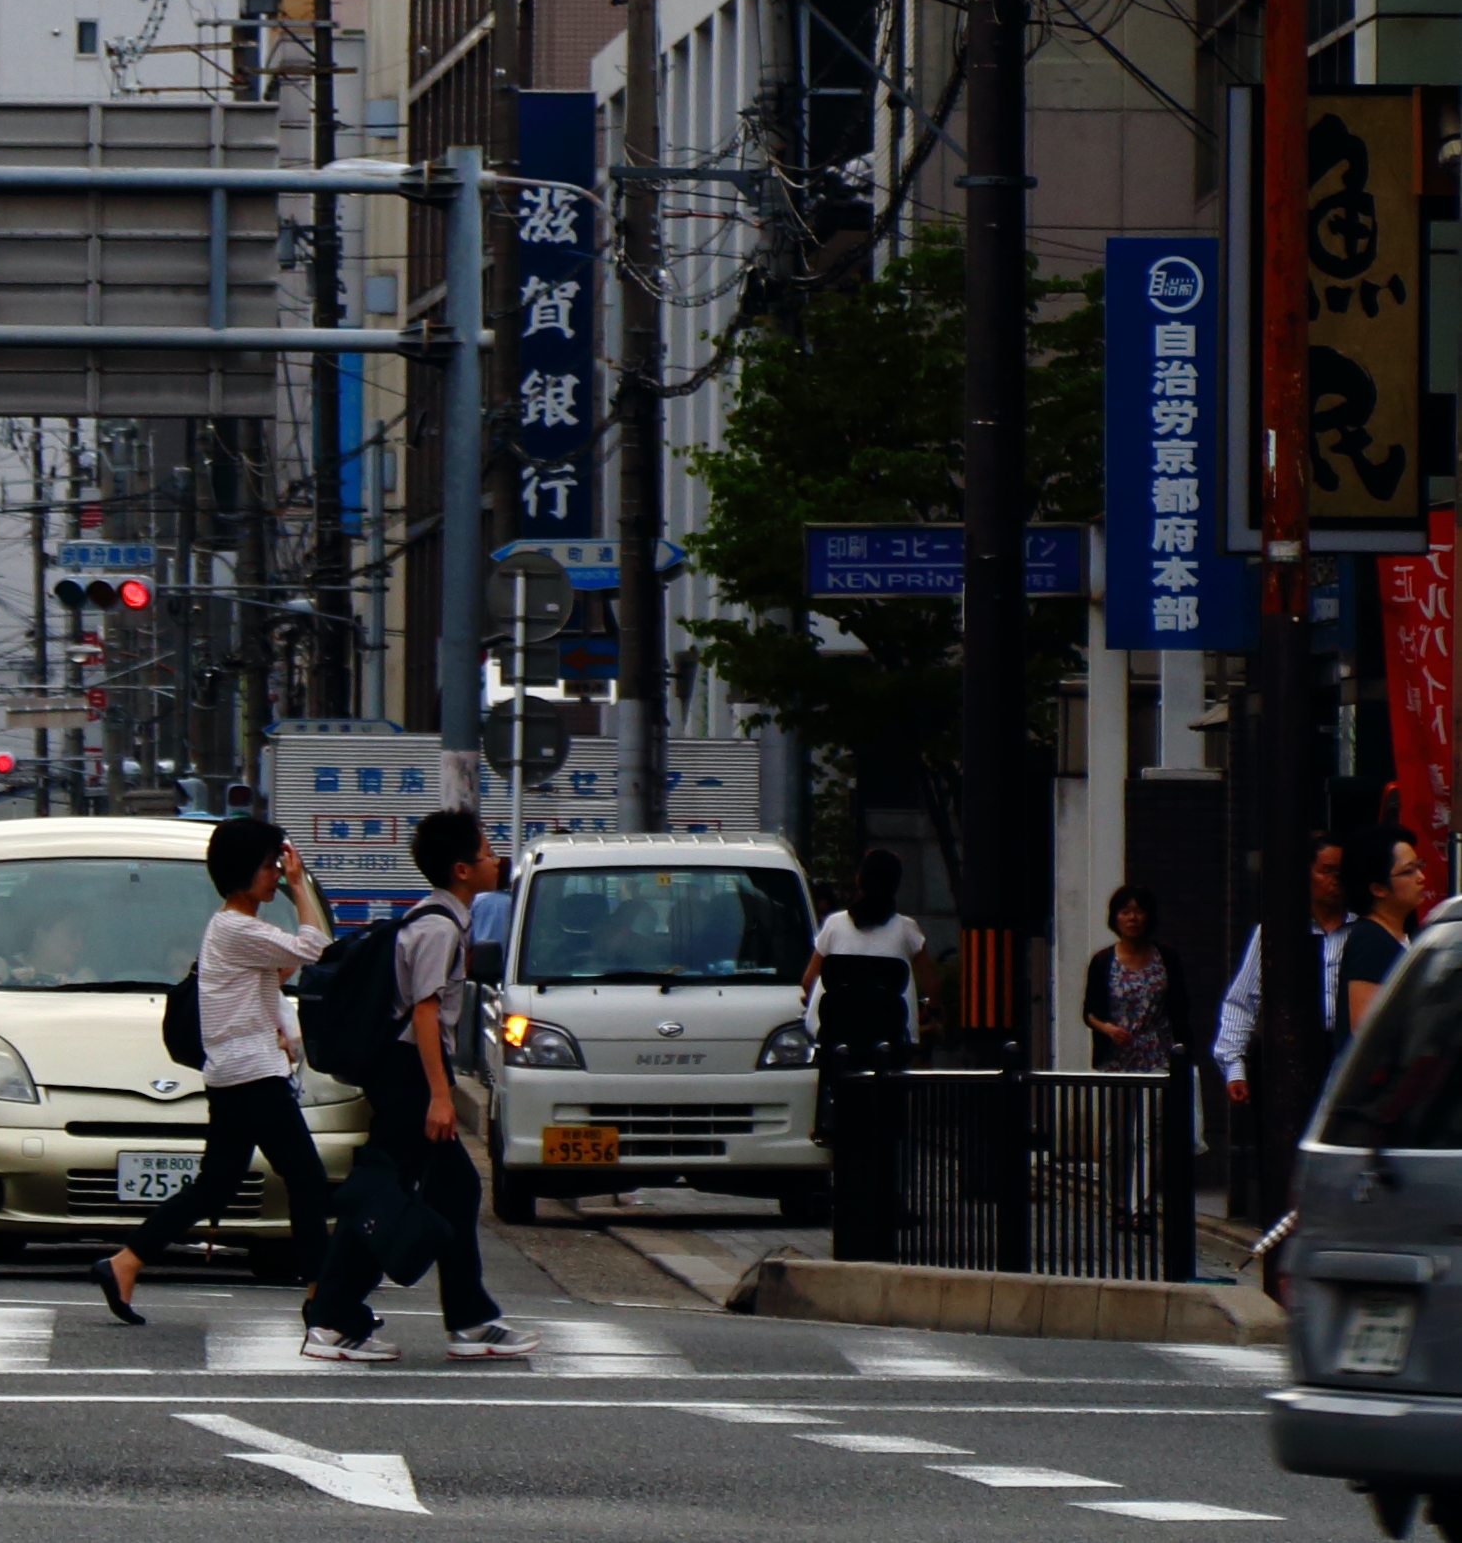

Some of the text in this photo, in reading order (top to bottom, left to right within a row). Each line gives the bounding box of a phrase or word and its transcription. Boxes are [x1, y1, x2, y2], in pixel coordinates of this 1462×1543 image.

[519, 188, 581, 521] 滋賀銀行
[1151, 322, 1200, 633] 自治労京都府本部
[827, 571, 881, 589] KEN
[636, 1052, 708, 1066] HIJET
[559, 1142, 615, 1162] 95-56
